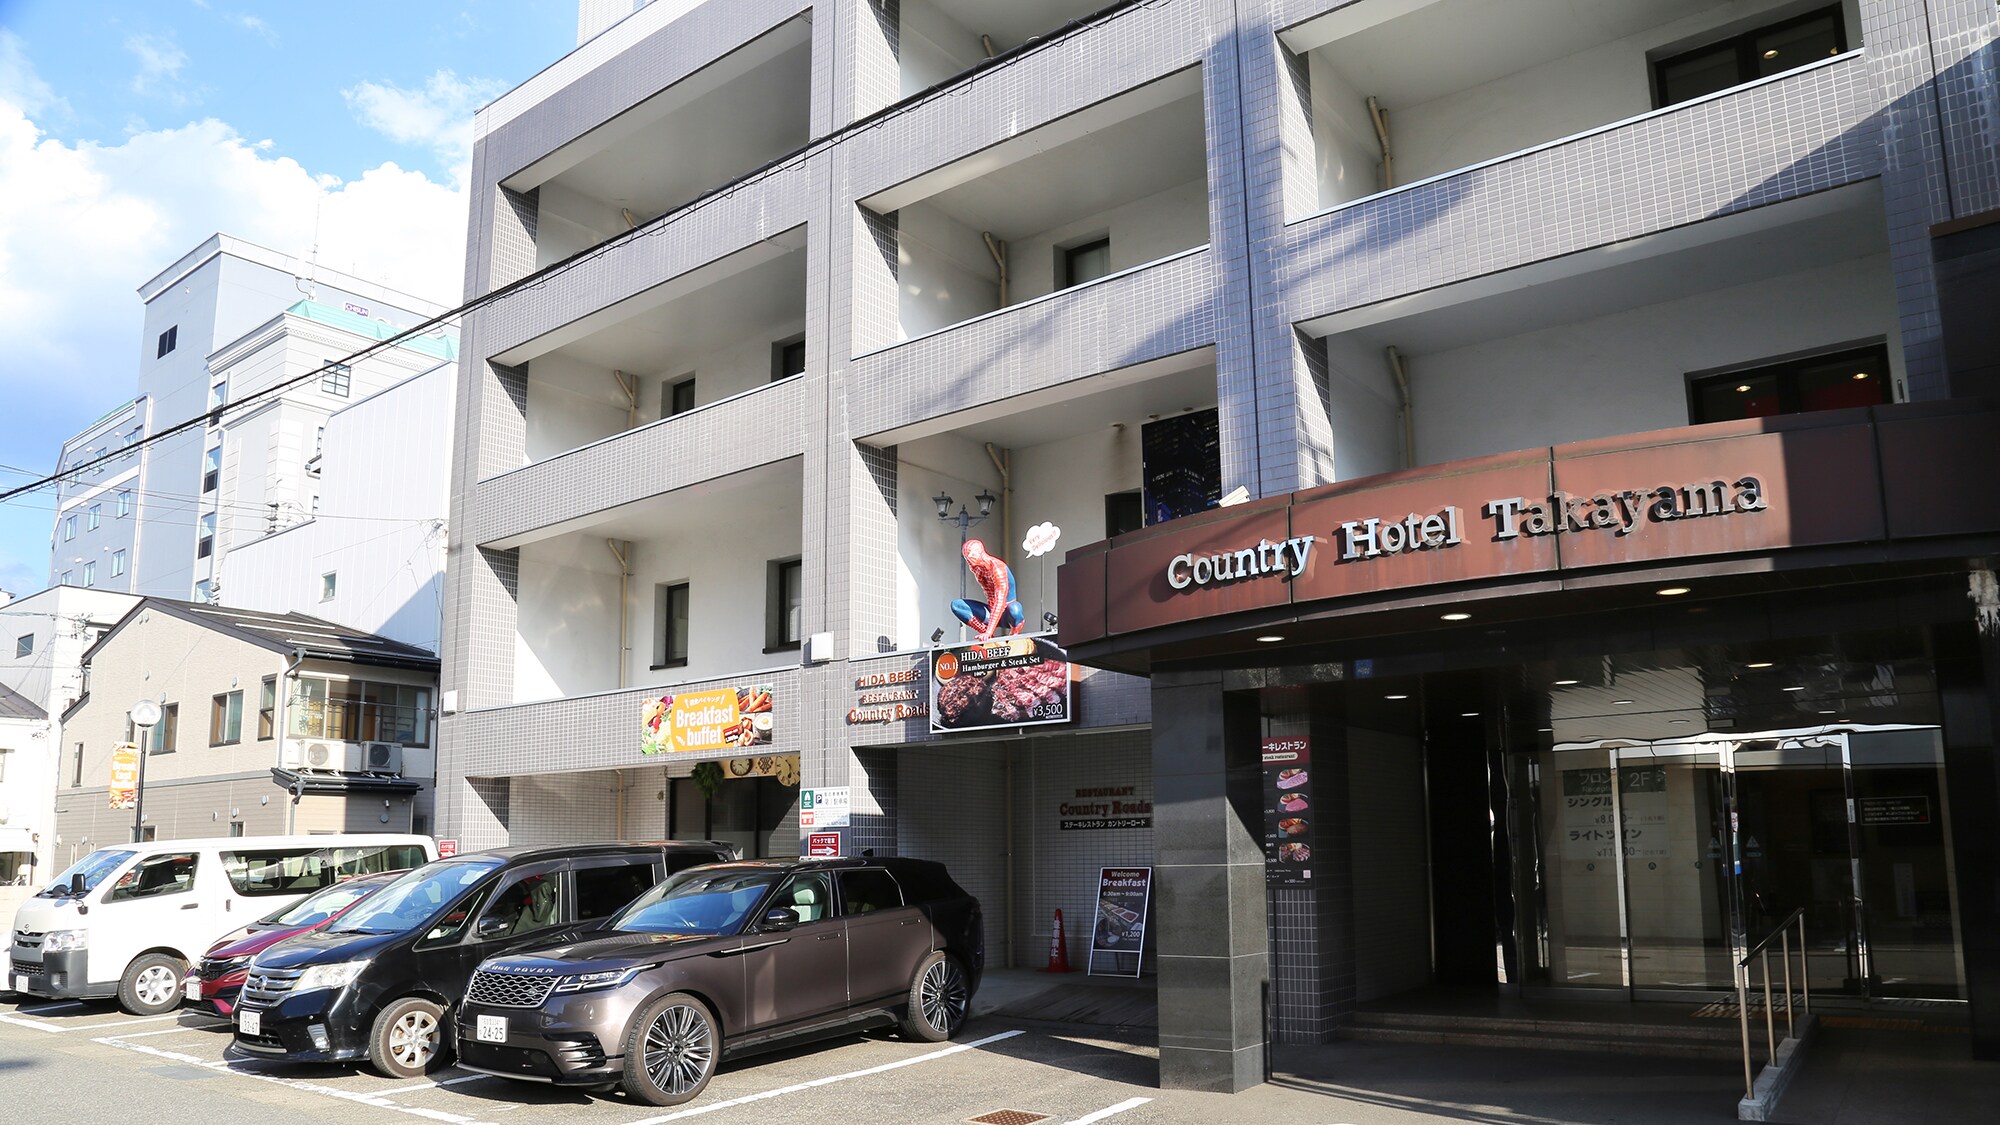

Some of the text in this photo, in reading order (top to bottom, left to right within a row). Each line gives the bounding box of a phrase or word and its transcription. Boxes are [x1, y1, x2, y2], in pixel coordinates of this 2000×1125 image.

[1168, 476, 1768, 589] Country Hotel Takayama
[961, 646, 1011, 662] HIDA BEEF
[939, 662, 957, 672] NO.1
[962, 661, 999, 673] Hamburger
[1008, 658, 1028, 667] Steak
[1029, 655, 1040, 664] Set
[858, 670, 921, 687] HIDA BEEF
[862, 690, 919, 704] RESTAURANT
[676, 704, 734, 728] Breakfast
[849, 702, 929, 724] Country Roads
[1033, 703, 1063, 717] ¥3,500
[687, 726, 721, 747] buffet
[1629, 771, 1651, 788] 2F
[1075, 786, 1135, 798] RESTAURANT
[1060, 800, 1152, 818] Country Roads
[1568, 796, 1613, 808] シングル
[1064, 819, 1146, 829] ステーキレストラン カントリーロード
[1102, 878, 1146, 887] Breakfast
[1121, 930, 1141, 939] ¥1,200
